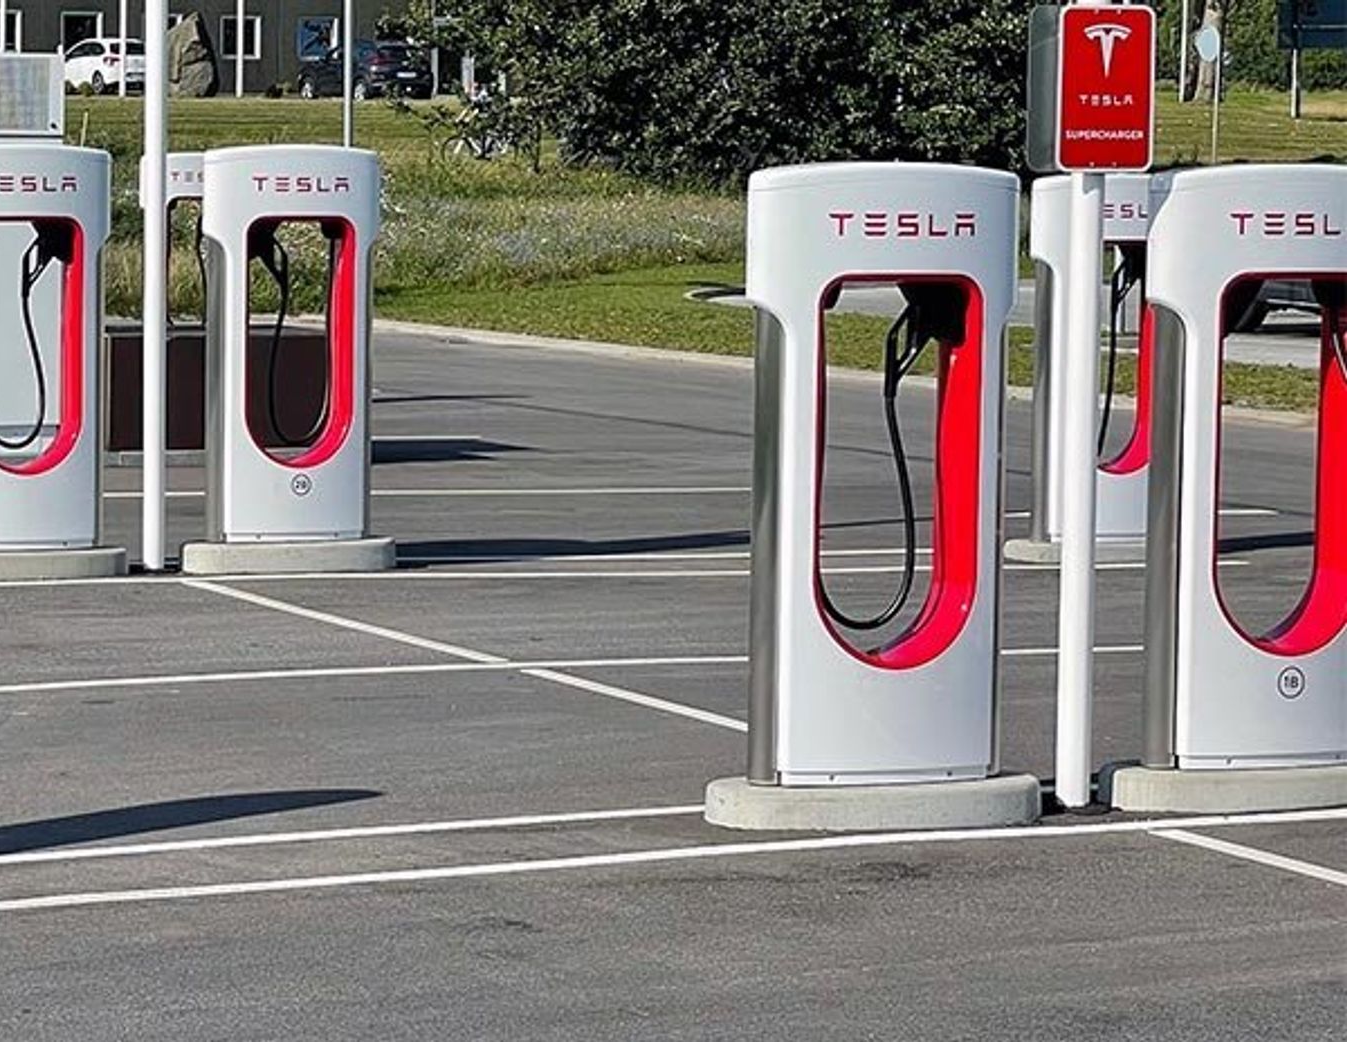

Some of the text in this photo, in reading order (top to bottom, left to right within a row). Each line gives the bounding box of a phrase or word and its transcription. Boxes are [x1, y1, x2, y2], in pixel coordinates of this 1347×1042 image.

[1079, 94, 1134, 106] TESLA
[1065, 130, 1144, 140] SUPERCHARGER
[252, 177, 349, 192] TESLA
[1103, 204, 1148, 219] ESL
[829, 213, 976, 236] TESLA
[1230, 213, 1341, 235] TESL
[1284, 676, 1299, 688] 1B
